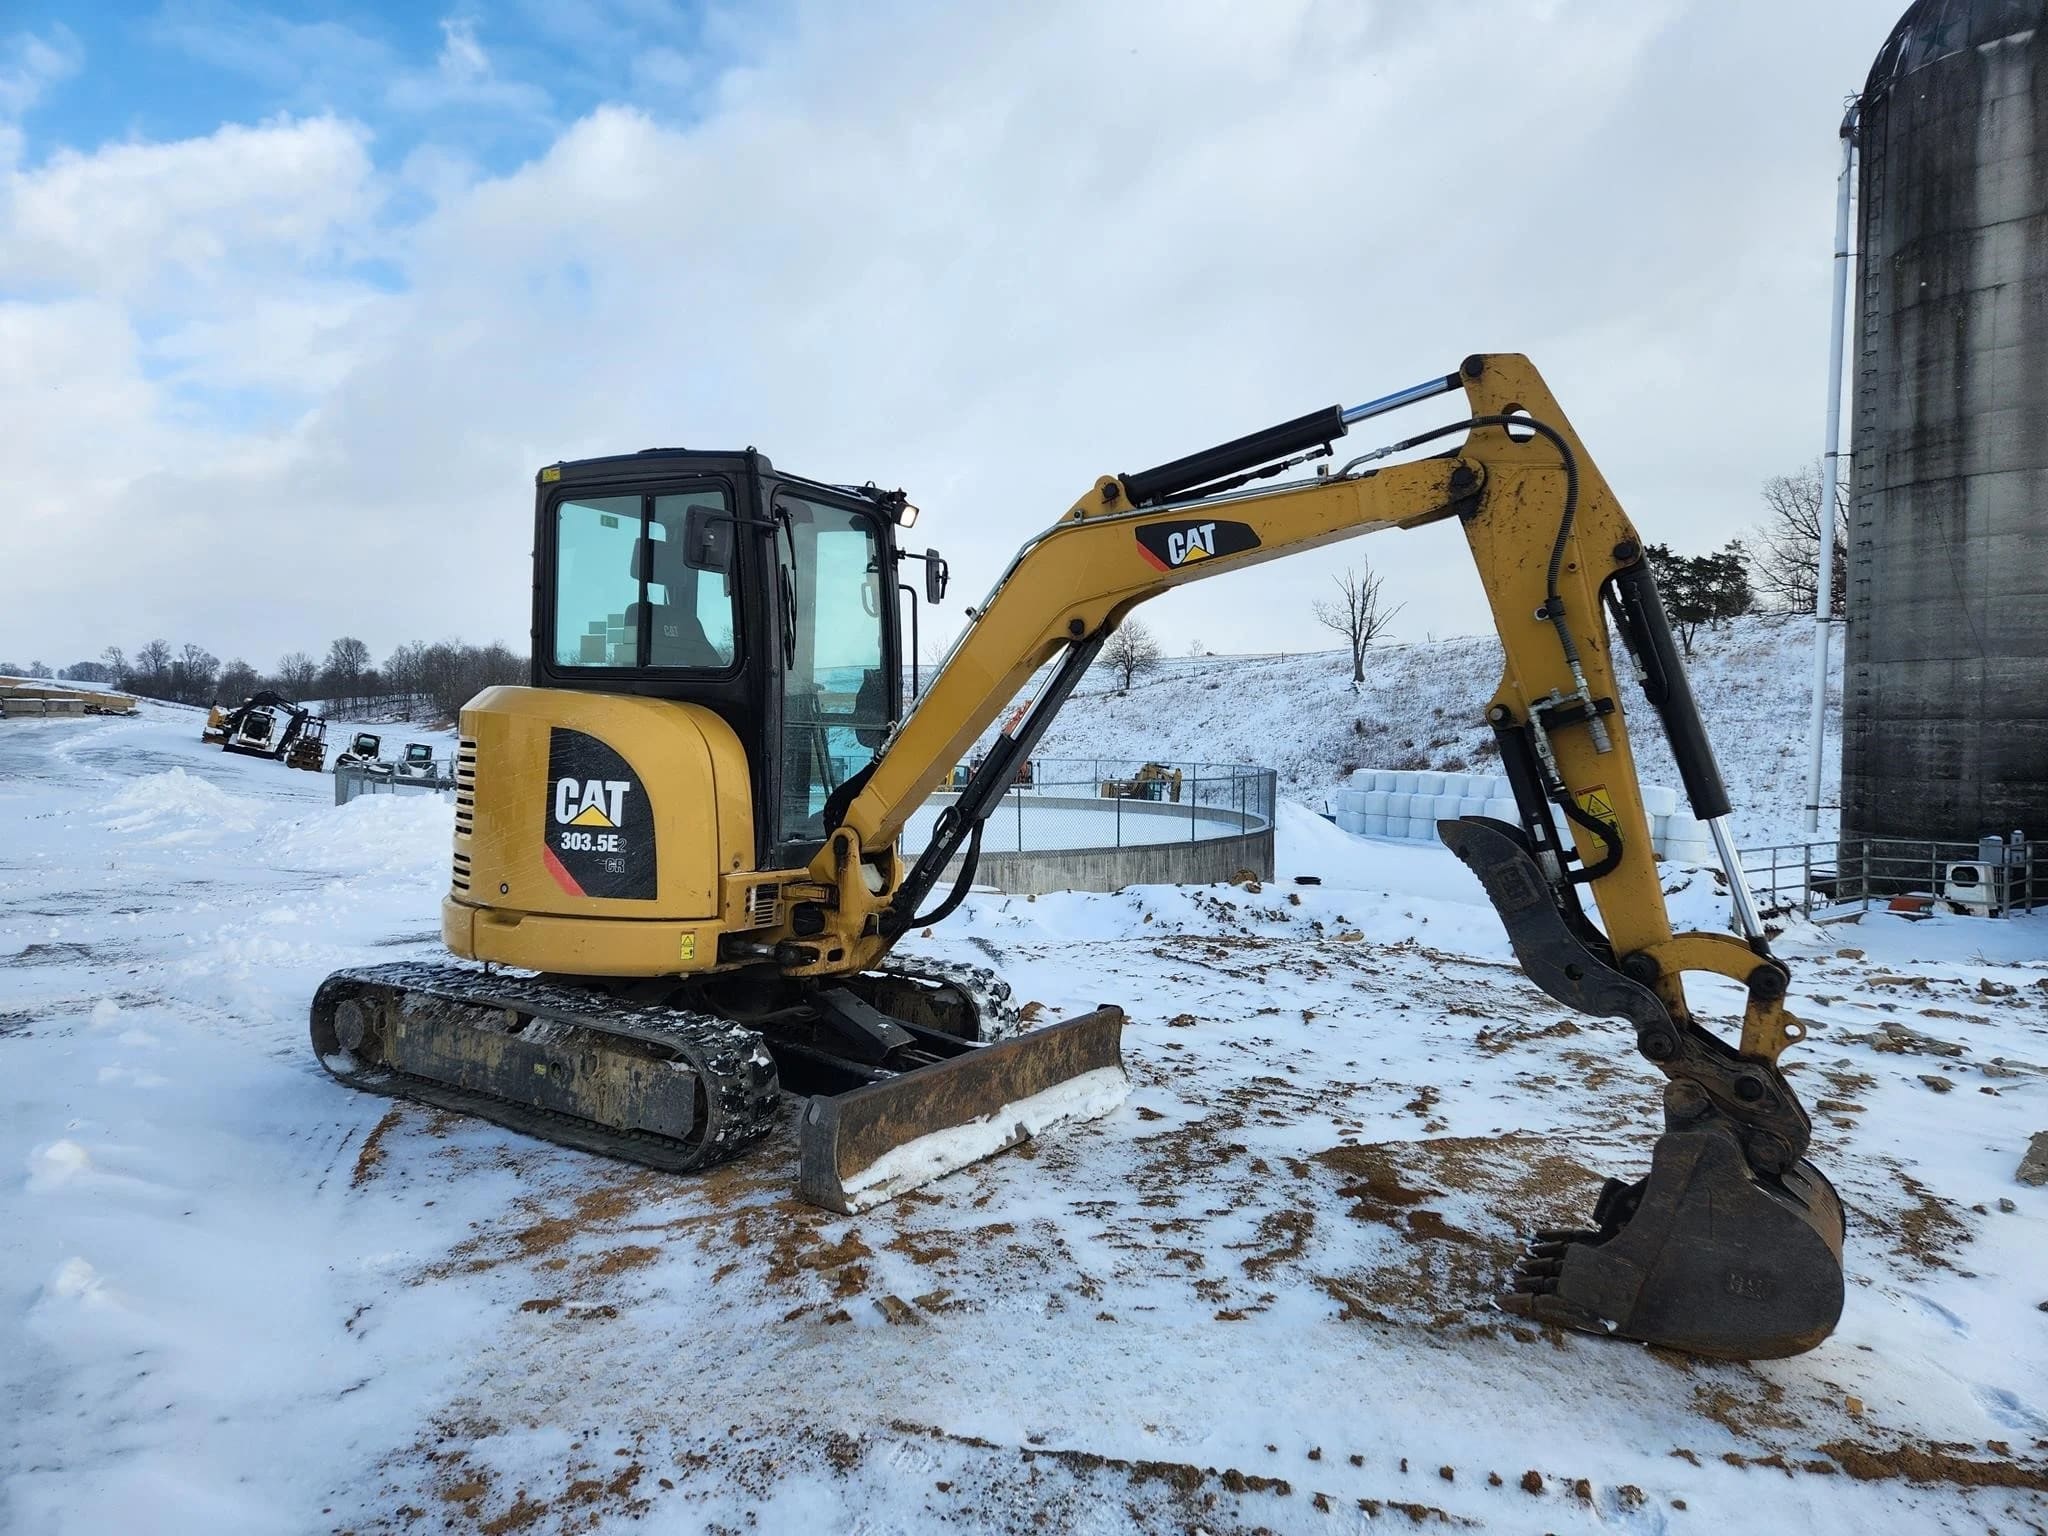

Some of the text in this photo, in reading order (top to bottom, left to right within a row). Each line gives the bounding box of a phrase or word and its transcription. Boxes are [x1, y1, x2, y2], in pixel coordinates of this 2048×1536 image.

[1167, 522, 1216, 565] CAT
[555, 777, 630, 828] CAT
[604, 857, 625, 873] CR
